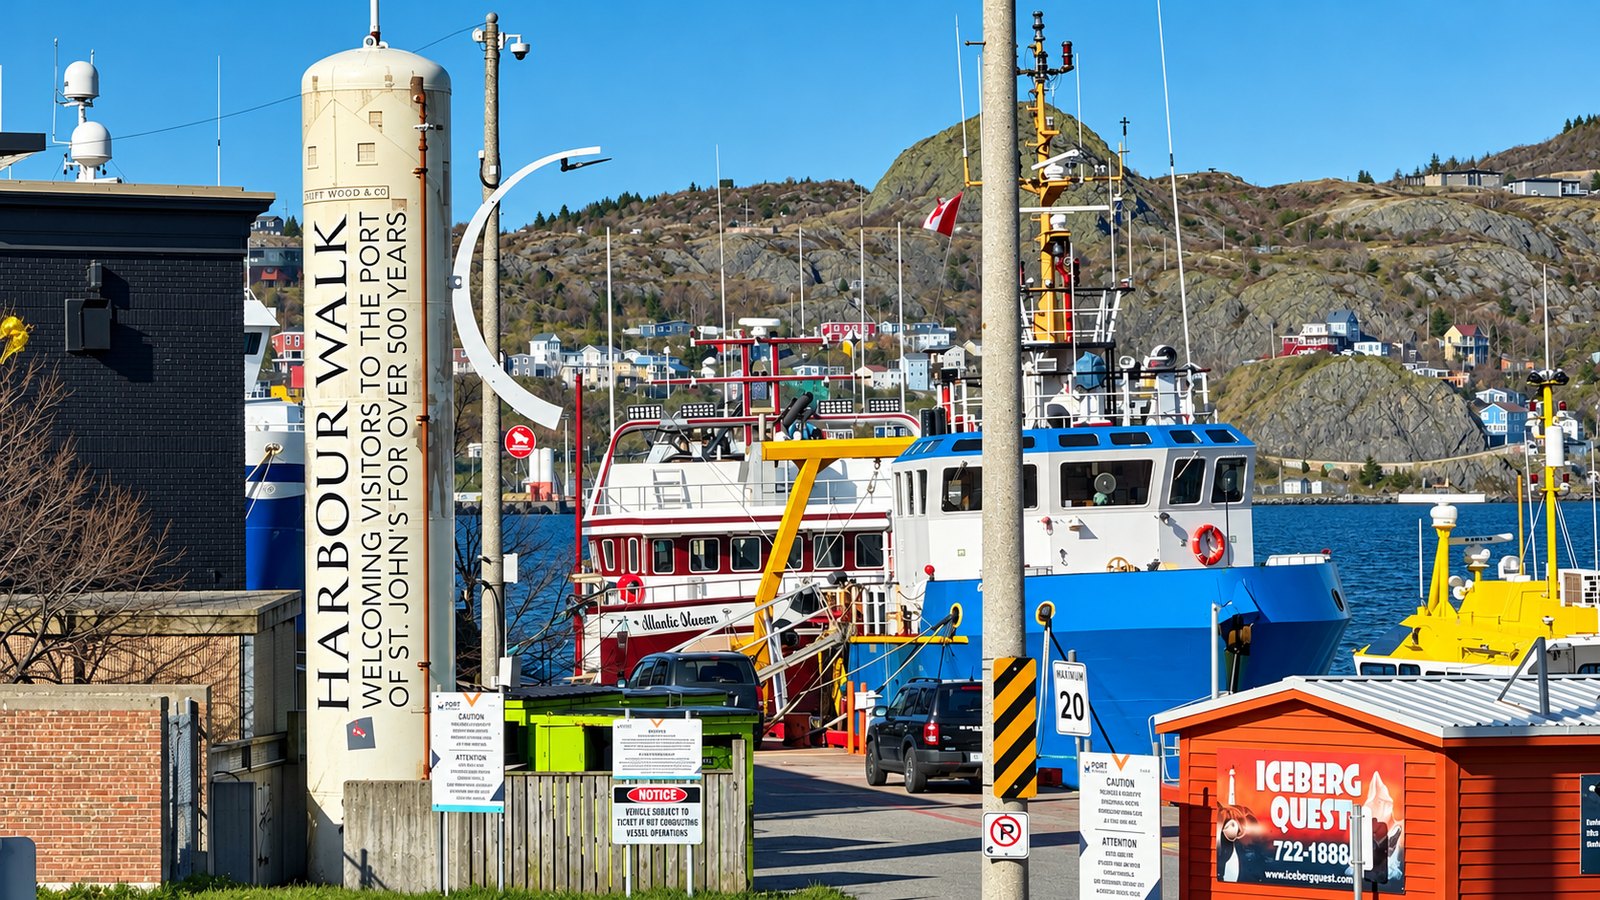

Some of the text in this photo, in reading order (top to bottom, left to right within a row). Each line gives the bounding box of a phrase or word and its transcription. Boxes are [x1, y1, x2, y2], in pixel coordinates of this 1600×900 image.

[328, 189, 360, 199] WOOD
[364, 188, 371, 197] &
[314, 214, 349, 712] HARBOUR WALK
[359, 211, 382, 709] WELCOMING VISITORS TO THE PORT
[386, 212, 410, 708] OF ST. JOHN'S FOR OVER 500 YEARS
[1060, 690, 1084, 721] 20
[458, 712, 485, 721] CAUTION
[455, 754, 487, 762] ATTENTION
[1106, 777, 1135, 788] CAUTION
[1256, 760, 1362, 797] ICEBERG
[638, 788, 677, 801] NOTICE
[682, 807, 690, 817] TO
[1270, 795, 1353, 833] QUEST
[626, 828, 649, 838] VESSEL
[1101, 836, 1138, 849] ATTENTION
[1273, 840, 1349, 865] 722-1888
[1265, 870, 1354, 884] www.icebergquest.com
